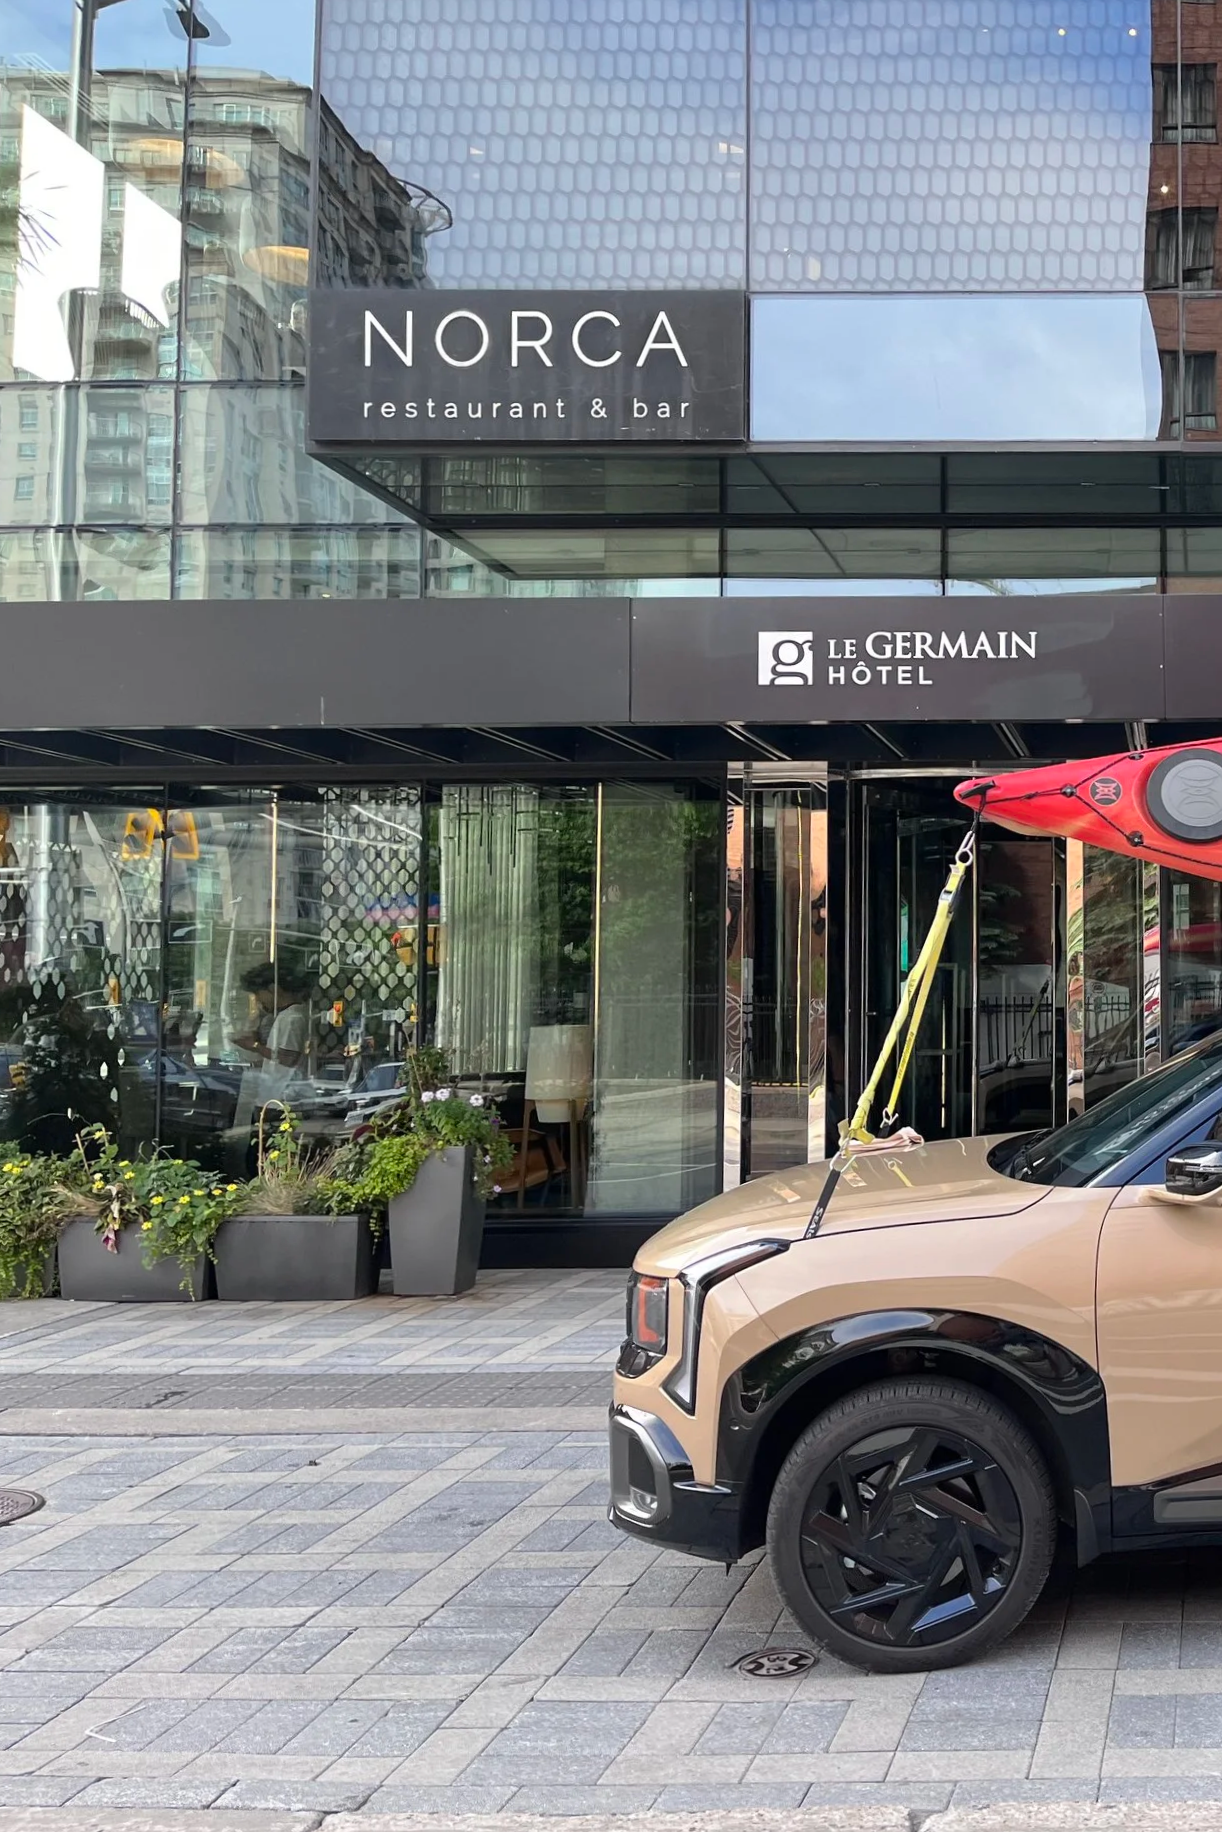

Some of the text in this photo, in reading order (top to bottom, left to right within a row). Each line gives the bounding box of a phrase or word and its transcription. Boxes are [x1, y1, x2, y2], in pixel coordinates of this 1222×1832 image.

[363, 309, 689, 368] NORCA
[363, 398, 690, 418] restaurant & bar
[827, 630, 1038, 660] LE GERMAIN
[828, 660, 934, 686] HÔTEL
